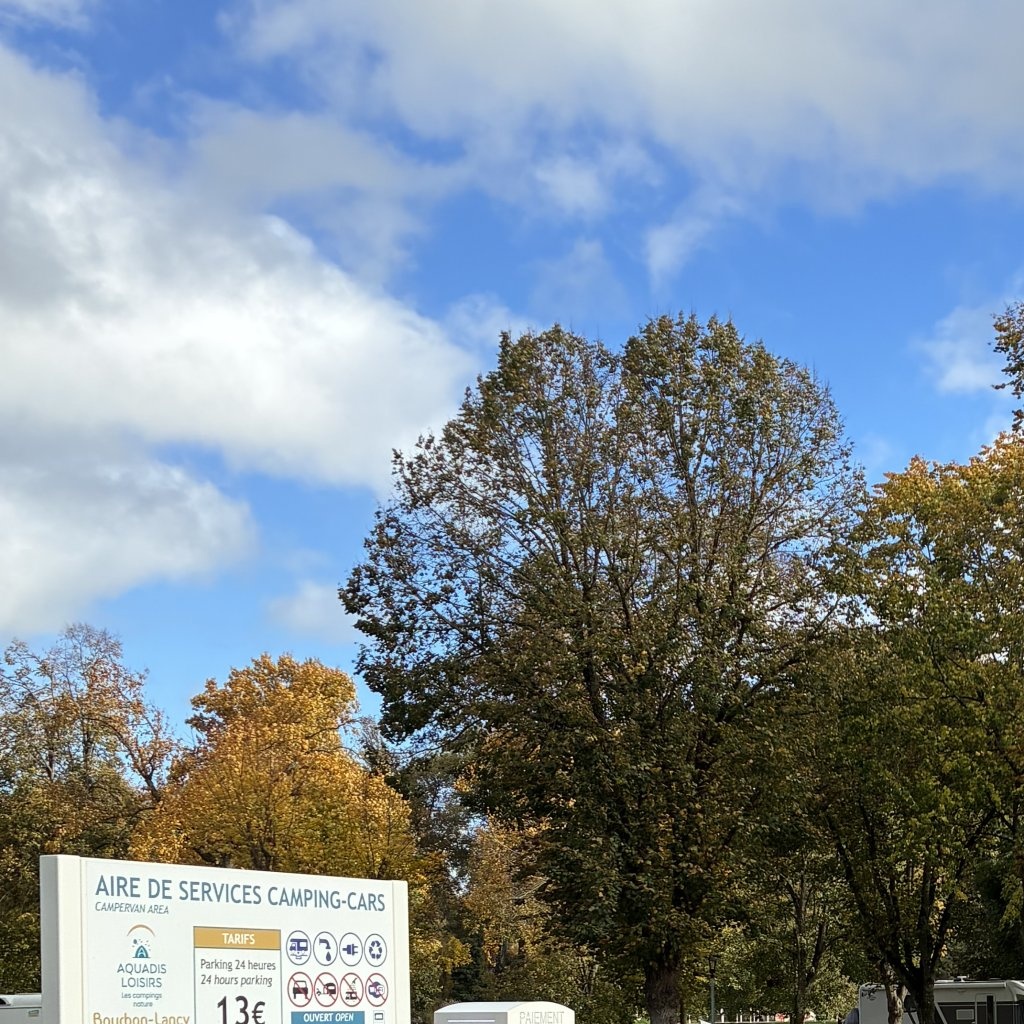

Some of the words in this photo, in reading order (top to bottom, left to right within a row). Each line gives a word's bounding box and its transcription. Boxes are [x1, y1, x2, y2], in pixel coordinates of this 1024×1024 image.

[95, 875, 141, 898] AIRE
[148, 878, 173, 900] DE
[179, 880, 262, 905] SERVICES
[267, 886, 386, 912] CAMPING-CARS
[94, 901, 146, 914] CAMPERVAN
[147, 904, 169, 914] AREA
[222, 933, 256, 945] TARIFS
[117, 963, 167, 976] AQUADIS
[200, 958, 233, 972] Parking
[235, 959, 246, 970] 24
[247, 960, 277, 971] heures
[121, 977, 163, 988] LOISIRS
[200, 974, 212, 985] 24
[213, 974, 239, 985] hours
[240, 975, 273, 988] parking
[132, 992, 163, 1000] campings
[303, 1013, 333, 1023] OUVERT
[335, 1012, 354, 1022] OPEN
[519, 1011, 565, 1024] PAIEMENT
